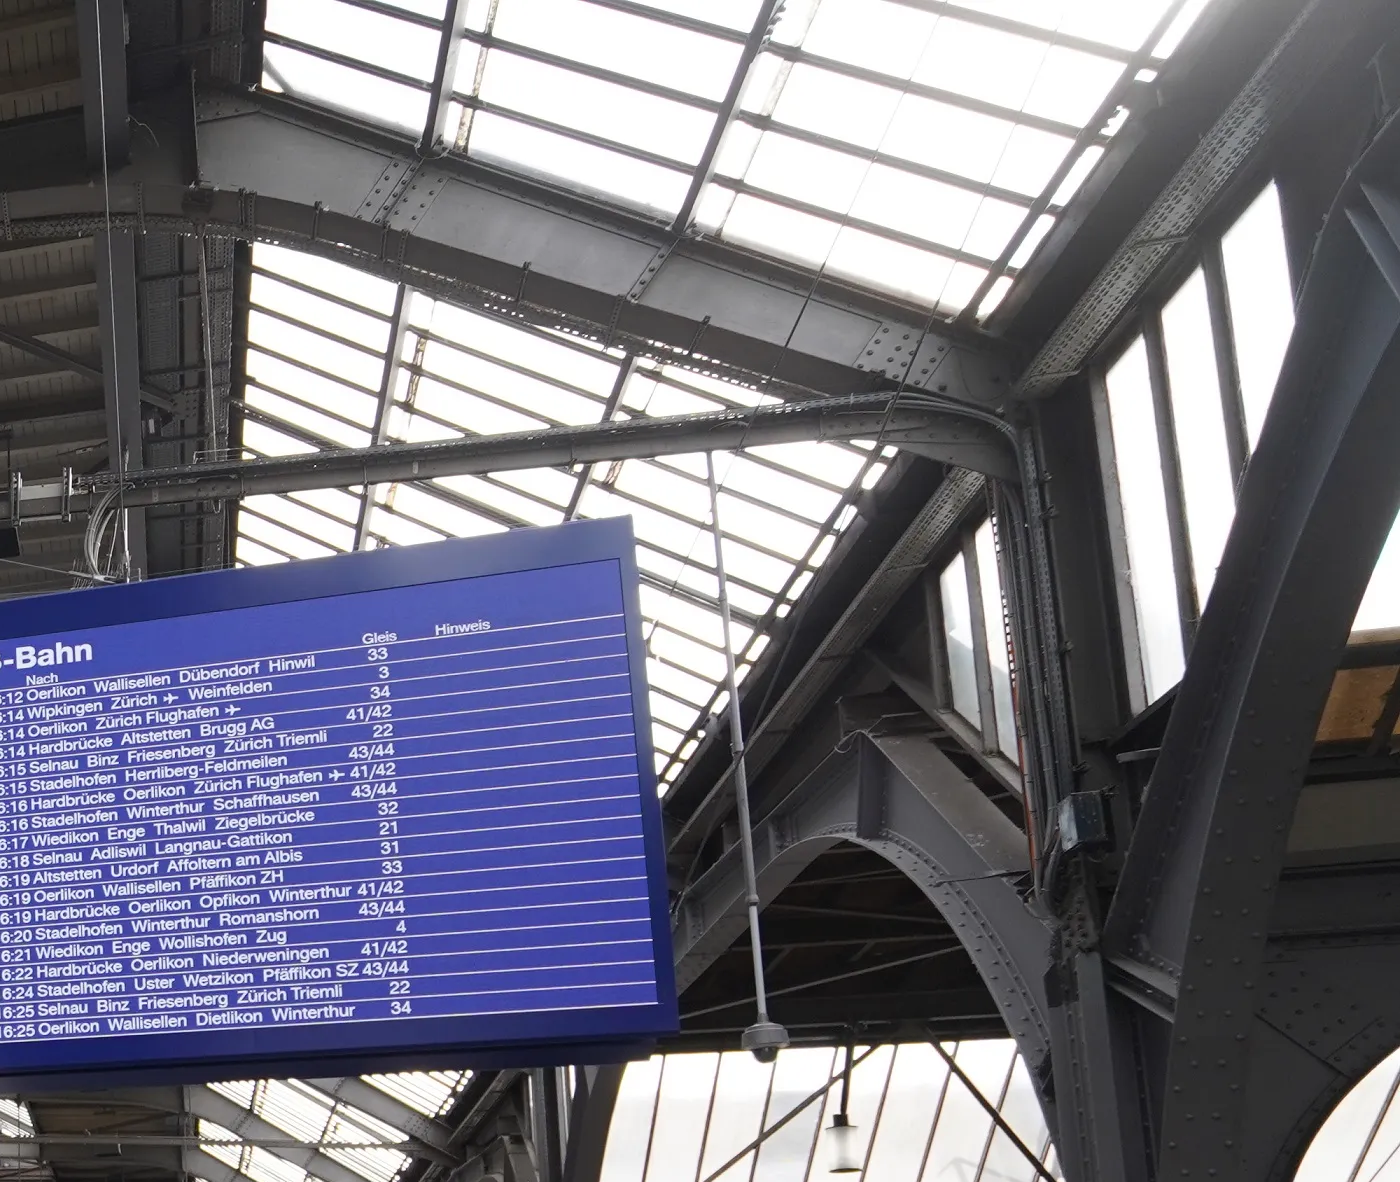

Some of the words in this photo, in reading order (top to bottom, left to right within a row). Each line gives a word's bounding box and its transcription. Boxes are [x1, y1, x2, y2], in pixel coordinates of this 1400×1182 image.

[362, 631, 397, 644] Gleis
[435, 620, 491, 636] Hinweis
[26, 685, 85, 700] Oerlikon
[93, 674, 170, 692] Wallisellen
[179, 661, 259, 682] Dübendorf
[268, 654, 315, 672] Hinwil
[367, 647, 387, 660] 33
[26, 673, 58, 686] Nach
[30, 772, 116, 791] Stadelhofen
[125, 755, 287, 782] Herrliberg-Feldmeilen
[348, 742, 394, 759] 43/44
[38, 1020, 99, 1035] Oerlikon
[107, 1015, 187, 1030] Wallisellen
[196, 1010, 262, 1025] Dietlikon
[271, 1004, 355, 1021] Winterthur
[390, 1000, 411, 1014] 34
